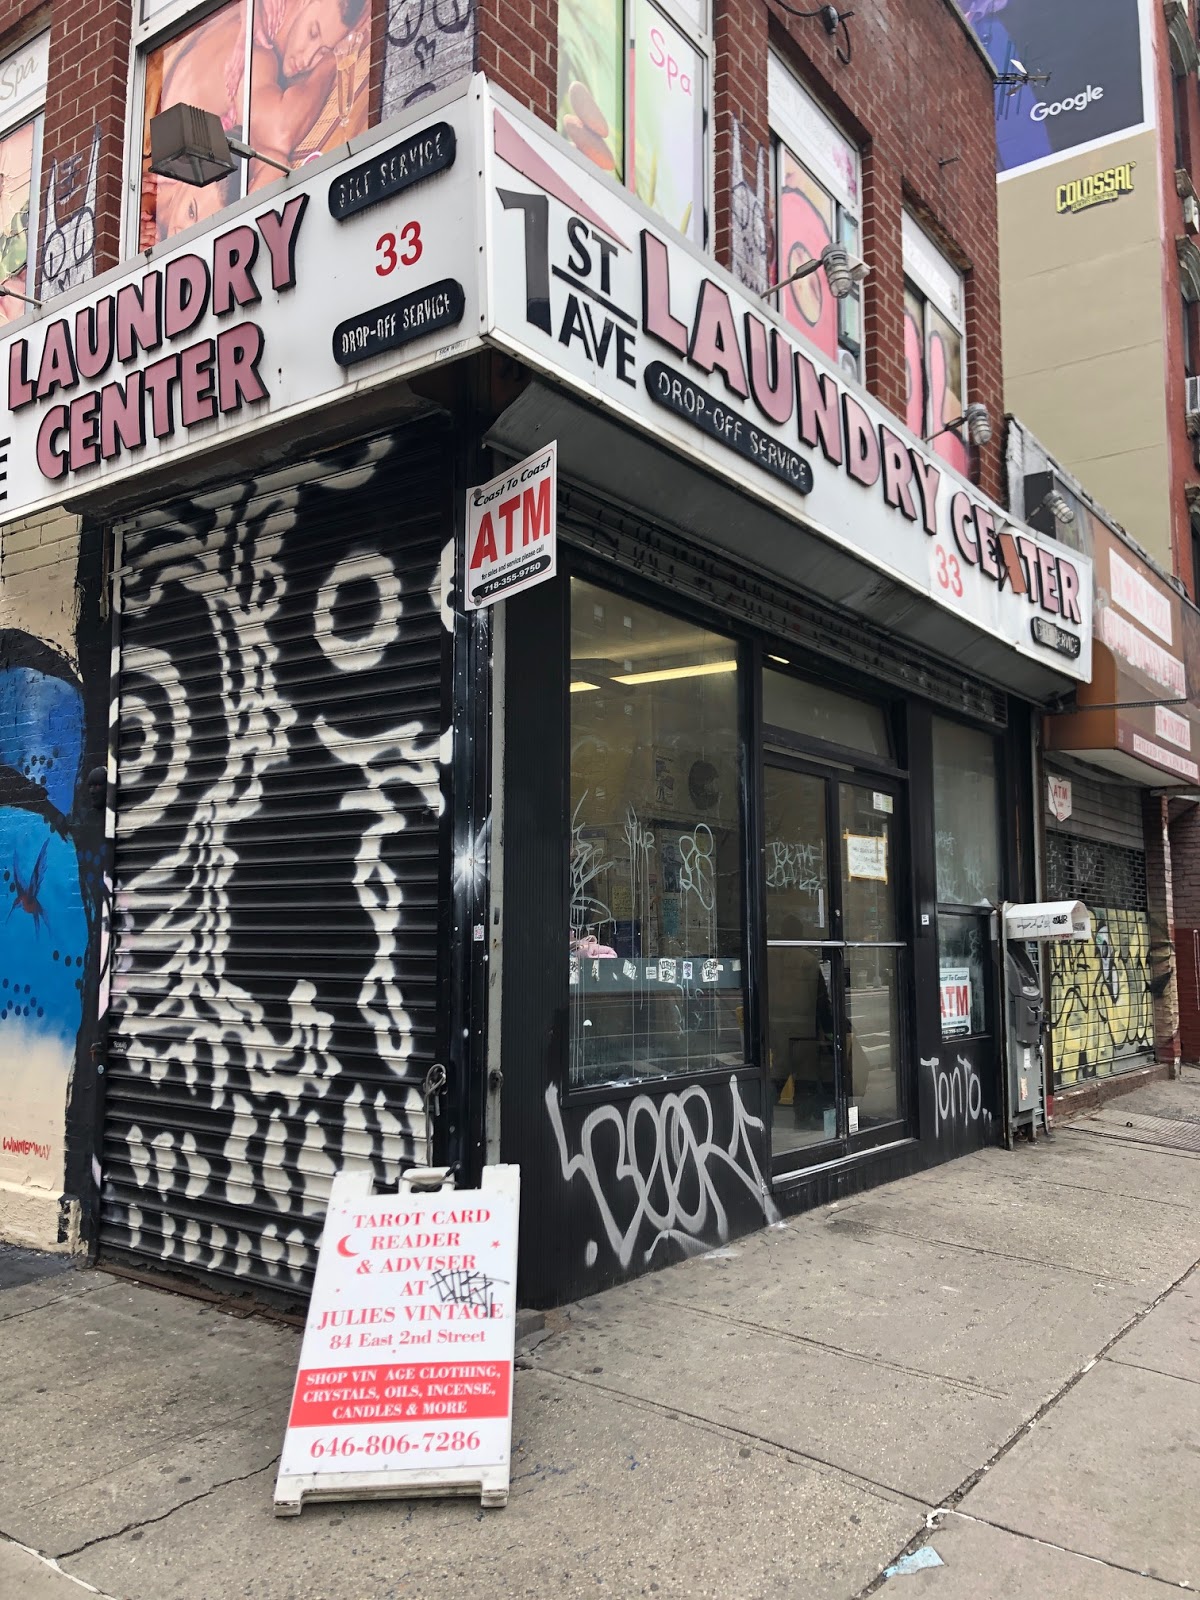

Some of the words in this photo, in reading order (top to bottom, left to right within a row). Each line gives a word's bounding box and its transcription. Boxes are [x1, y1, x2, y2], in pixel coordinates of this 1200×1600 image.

[1, 56, 39, 101] Spa
[650, 28, 692, 96] Spa
[1029, 84, 1104, 122] Google
[380, 132, 444, 187] SERVICE
[1056, 162, 1134, 214] COLOSSAL
[375, 220, 423, 277] 33
[567, 216, 618, 296] ST
[8, 193, 310, 412] LAUNDRY
[341, 312, 397, 354] DROP-OFF
[402, 292, 451, 329] SERVICE
[558, 292, 637, 390] AVE
[36, 321, 271, 480] CENTER
[639, 228, 940, 536] LAUNDRY
[658, 371, 743, 441] DROP-OFF
[750, 430, 807, 485] SERVICE
[474, 483, 505, 507] Coast
[507, 477, 518, 493] To
[520, 456, 552, 483] Coast
[469, 476, 551, 570] ATM
[484, 561, 541, 594] 718-355-9750
[935, 543, 964, 598] 33
[1053, 784, 1068, 800] ATM
[940, 985, 969, 1019] ATM
[353, 1211, 426, 1229] TAROT
[432, 1208, 491, 1226] CARD
[369, 1231, 461, 1251] READER
[356, 1259, 373, 1275] &
[379, 1254, 477, 1274] ADVISER
[400, 1279, 429, 1297] AT
[316, 1306, 396, 1331] JULIES
[404, 1302, 504, 1322] VINTAGE
[329, 1334, 353, 1351] 84
[358, 1332, 394, 1348] East
[399, 1329, 432, 1346] 2nd
[437, 1328, 486, 1345] Street
[302, 1386, 381, 1404] CRYSTALS,
[384, 1383, 424, 1400] OILS,
[427, 1381, 497, 1398] INCENSE,
[305, 1372, 348, 1387] SHOP
[419, 1364, 502, 1380] CLOTHING,
[331, 1403, 402, 1420] CANDLES
[405, 1402, 418, 1416] &
[422, 1400, 468, 1415] MORE
[310, 1429, 482, 1459] 646-806-7286
